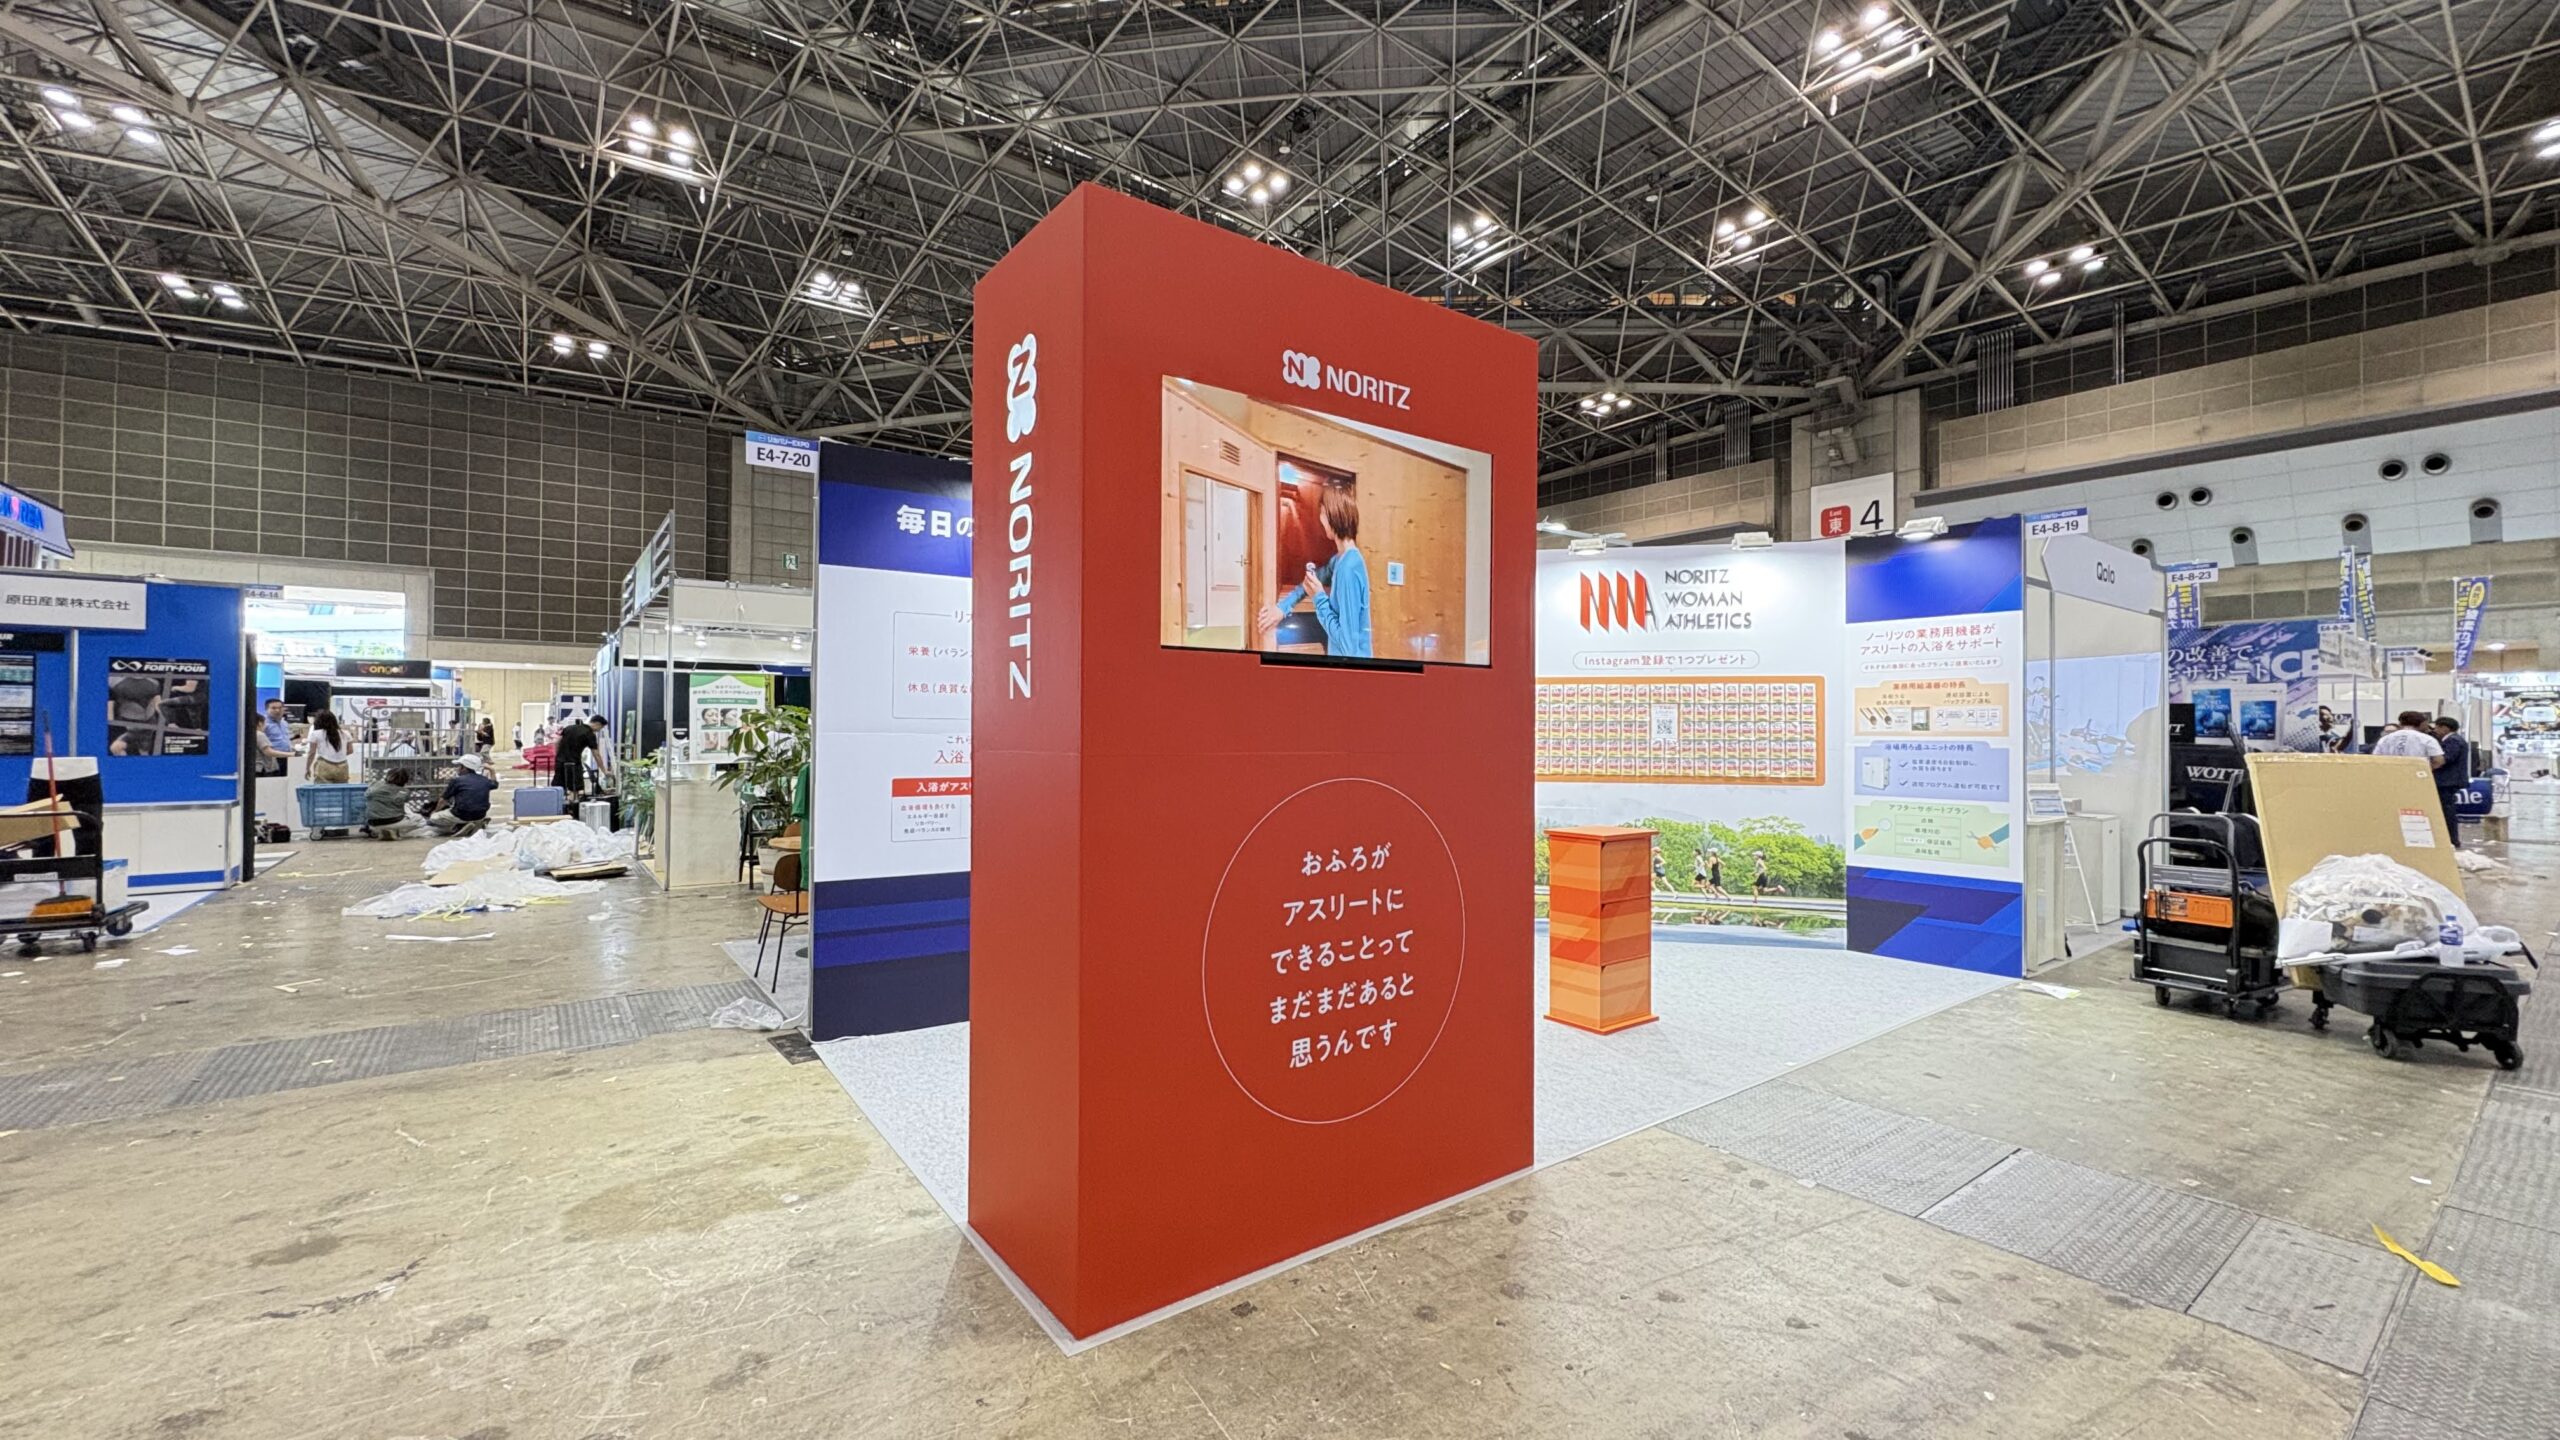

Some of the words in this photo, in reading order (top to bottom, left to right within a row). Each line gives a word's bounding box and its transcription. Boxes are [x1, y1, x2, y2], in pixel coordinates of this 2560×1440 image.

[1327, 365, 1411, 410] NORITZ
[757, 447, 811, 467] E4-7-20
[896, 504, 973, 538] 毎日の
[1860, 499, 1884, 530] 4
[1829, 517, 1843, 534] 東
[2032, 520, 2079, 535] E4-8-19
[1009, 451, 1033, 700] NORITZ
[1665, 568, 1729, 584] NORITZ
[2171, 571, 2211, 582] E4-8-23
[6, 594, 131, 610] 原田産業株式会社
[1664, 591, 1743, 607] WOMAN
[1664, 612, 1752, 629] ATHLETICS
[1866, 624, 1996, 641] ノーリツの業務用機器が
[1860, 637, 2003, 655] アスリートの入浴をサポート
[143, 663, 207, 673] FORTY-FOUR
[1584, 655, 1747, 668] Instagram登録で1つプレゼント
[935, 750, 965, 764] 入浴
[1301, 842, 1392, 876] おふろが
[1283, 888, 1404, 926] アスリートに
[1271, 930, 1415, 975] できることって
[1270, 972, 1415, 1024] まだまだあると
[1289, 1018, 1398, 1068] 思うんです
